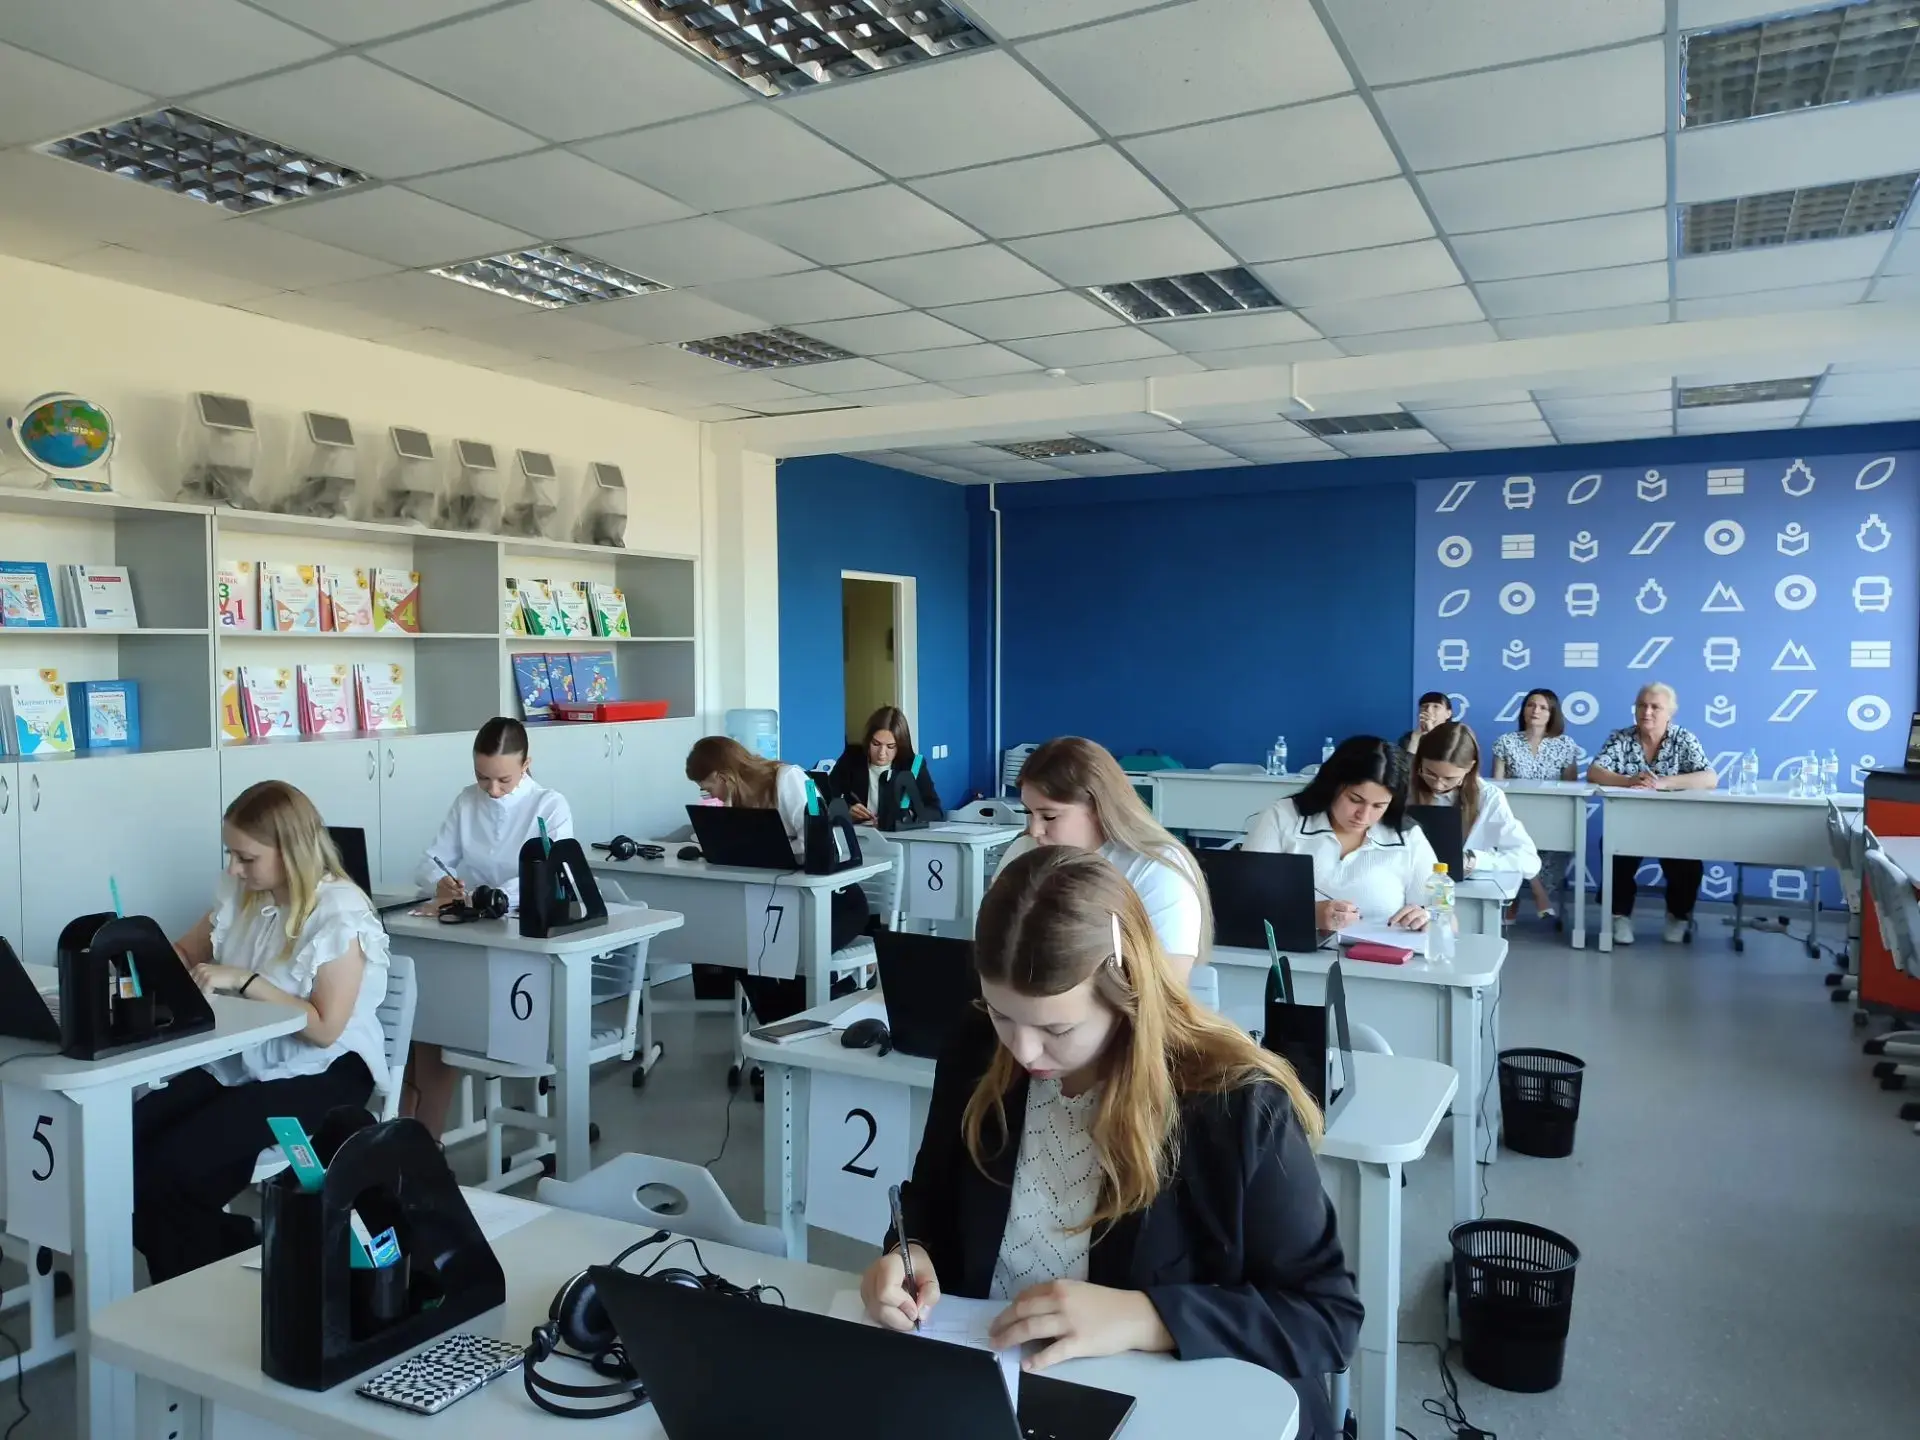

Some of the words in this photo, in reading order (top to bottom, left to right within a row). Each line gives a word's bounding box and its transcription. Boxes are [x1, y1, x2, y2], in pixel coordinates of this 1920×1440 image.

[303, 608, 317, 628] 2
[356, 609, 370, 626] 3
[399, 600, 416, 626] 4
[550, 616, 561, 631] 2
[579, 616, 589, 631] 3
[619, 617, 628, 632] 4
[225, 704, 240, 726] 1
[280, 711, 293, 728] 2
[334, 707, 346, 724] 3
[53, 720, 68, 742] 4
[927, 859, 944, 892] 8
[765, 905, 784, 944] 7
[510, 973, 533, 1021] 6
[31, 1114, 55, 1182] 5
[841, 1108, 879, 1179] 2
